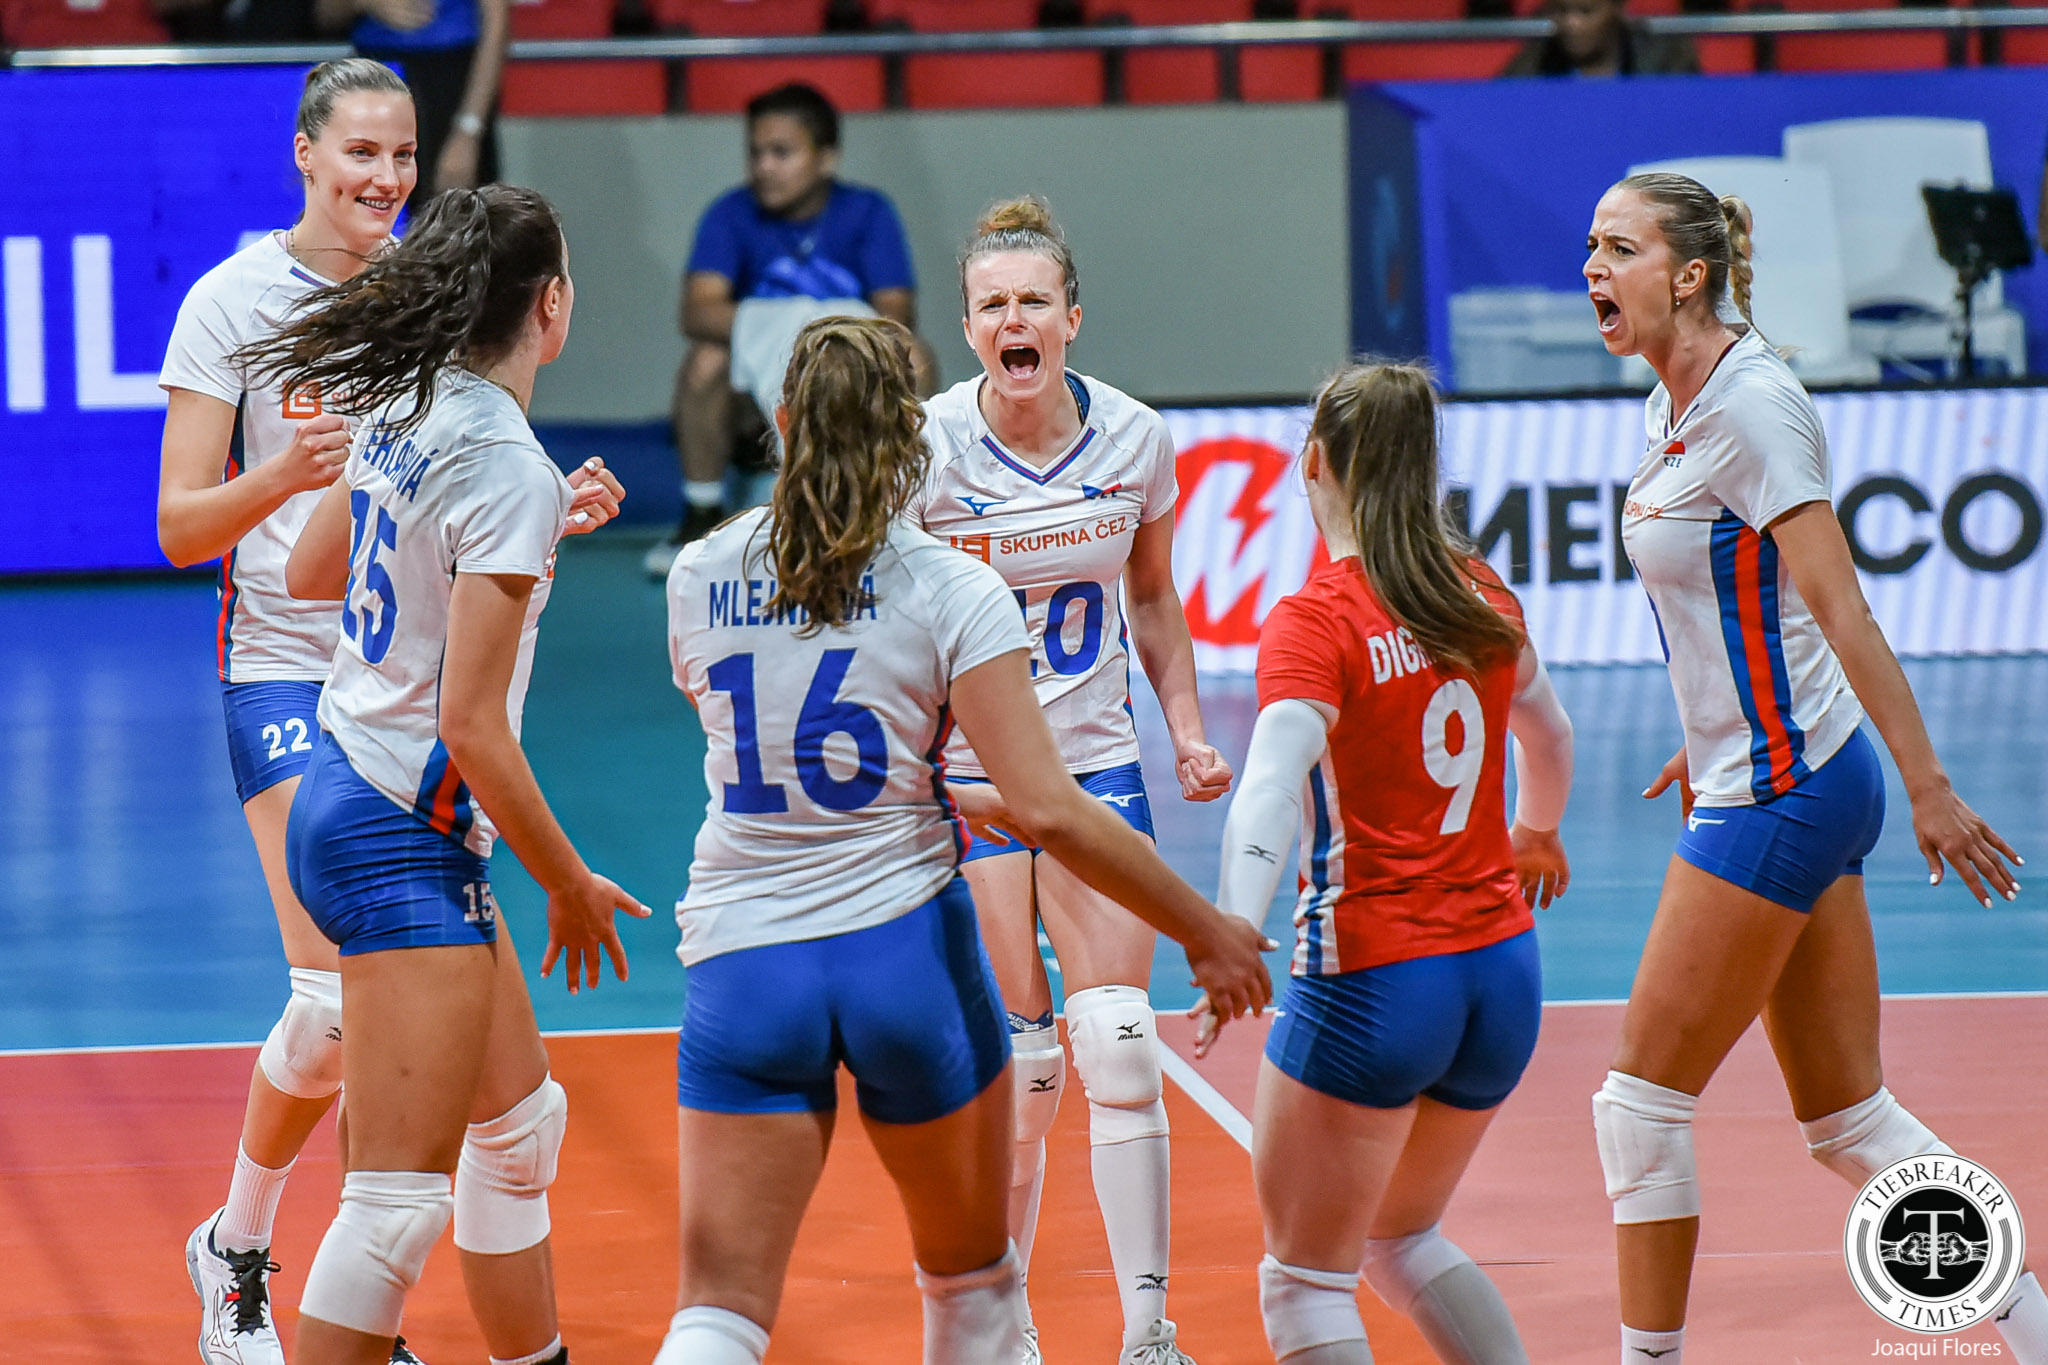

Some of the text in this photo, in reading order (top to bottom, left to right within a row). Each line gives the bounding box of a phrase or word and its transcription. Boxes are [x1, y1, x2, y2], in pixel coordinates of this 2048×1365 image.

[341, 488, 398, 665] 15
[1000, 515, 1127, 555] SKUPINA ČEZ
[262, 717, 313, 761] 22
[707, 647, 889, 814] 16
[1421, 678, 1485, 835] 9
[463, 881, 494, 922] 15
